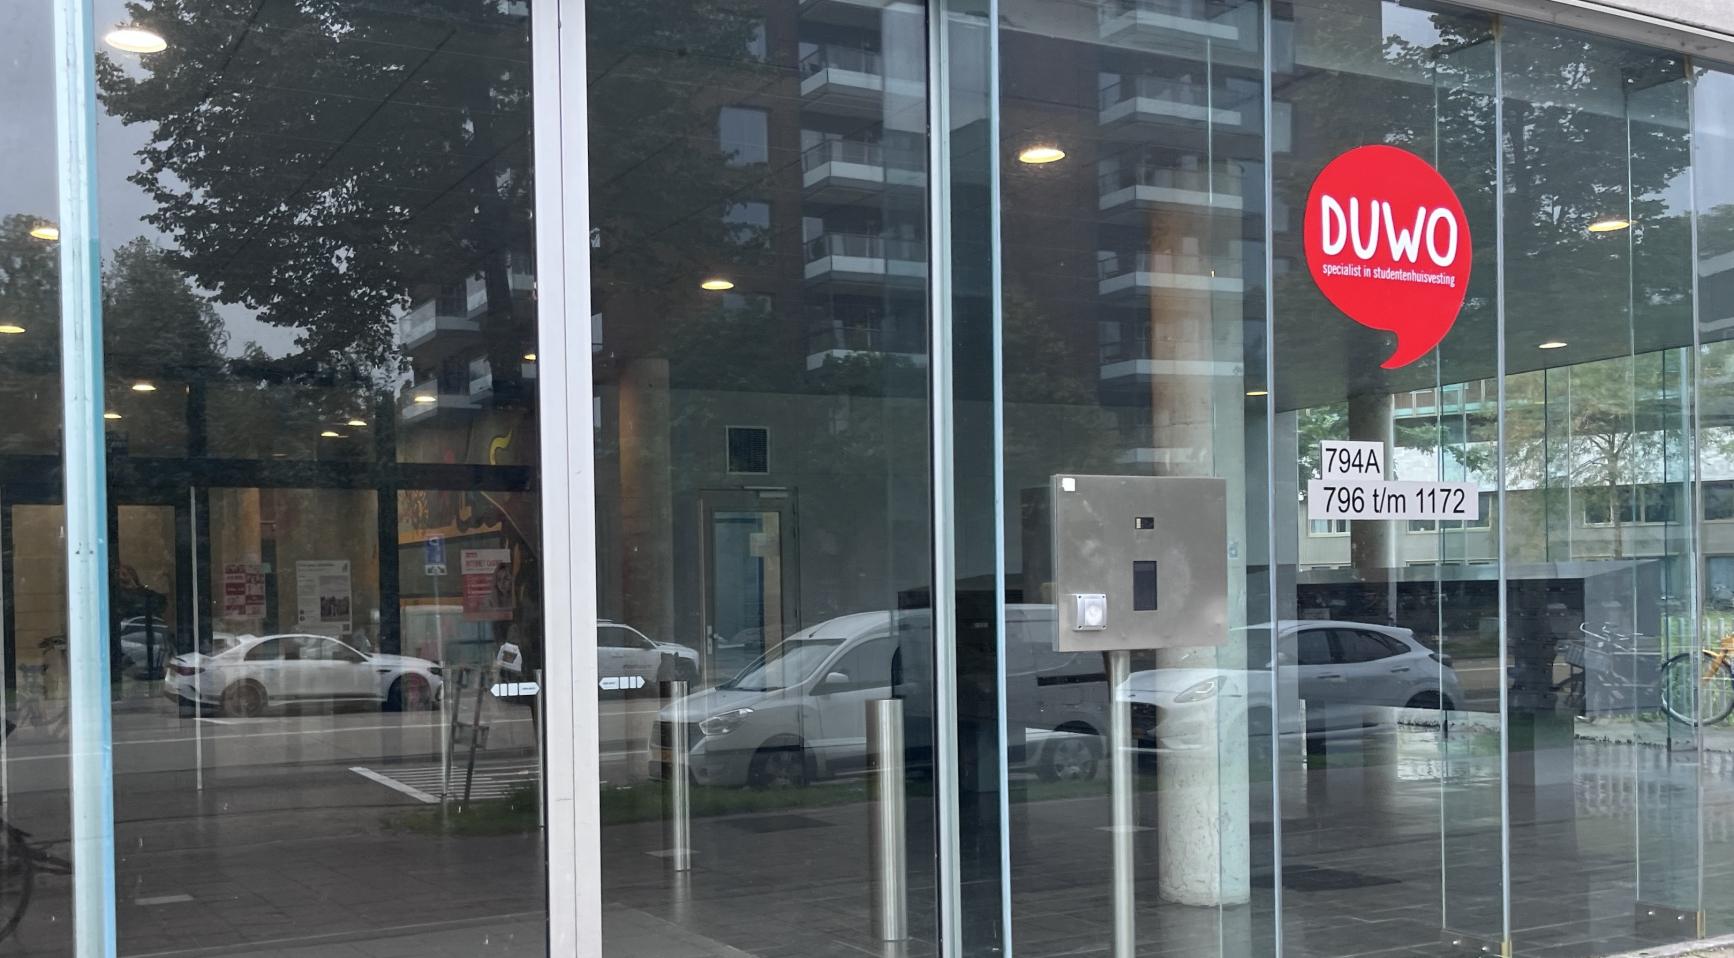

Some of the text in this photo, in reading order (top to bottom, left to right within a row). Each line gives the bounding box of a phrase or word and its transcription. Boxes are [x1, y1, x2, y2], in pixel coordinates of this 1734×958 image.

[1321, 194, 1458, 267] DUWO
[1322, 263, 1456, 288] specialist in studentenhuisvesting
[1325, 448, 1381, 474] 794A
[1323, 486, 1465, 514] 796 t/m 1172
